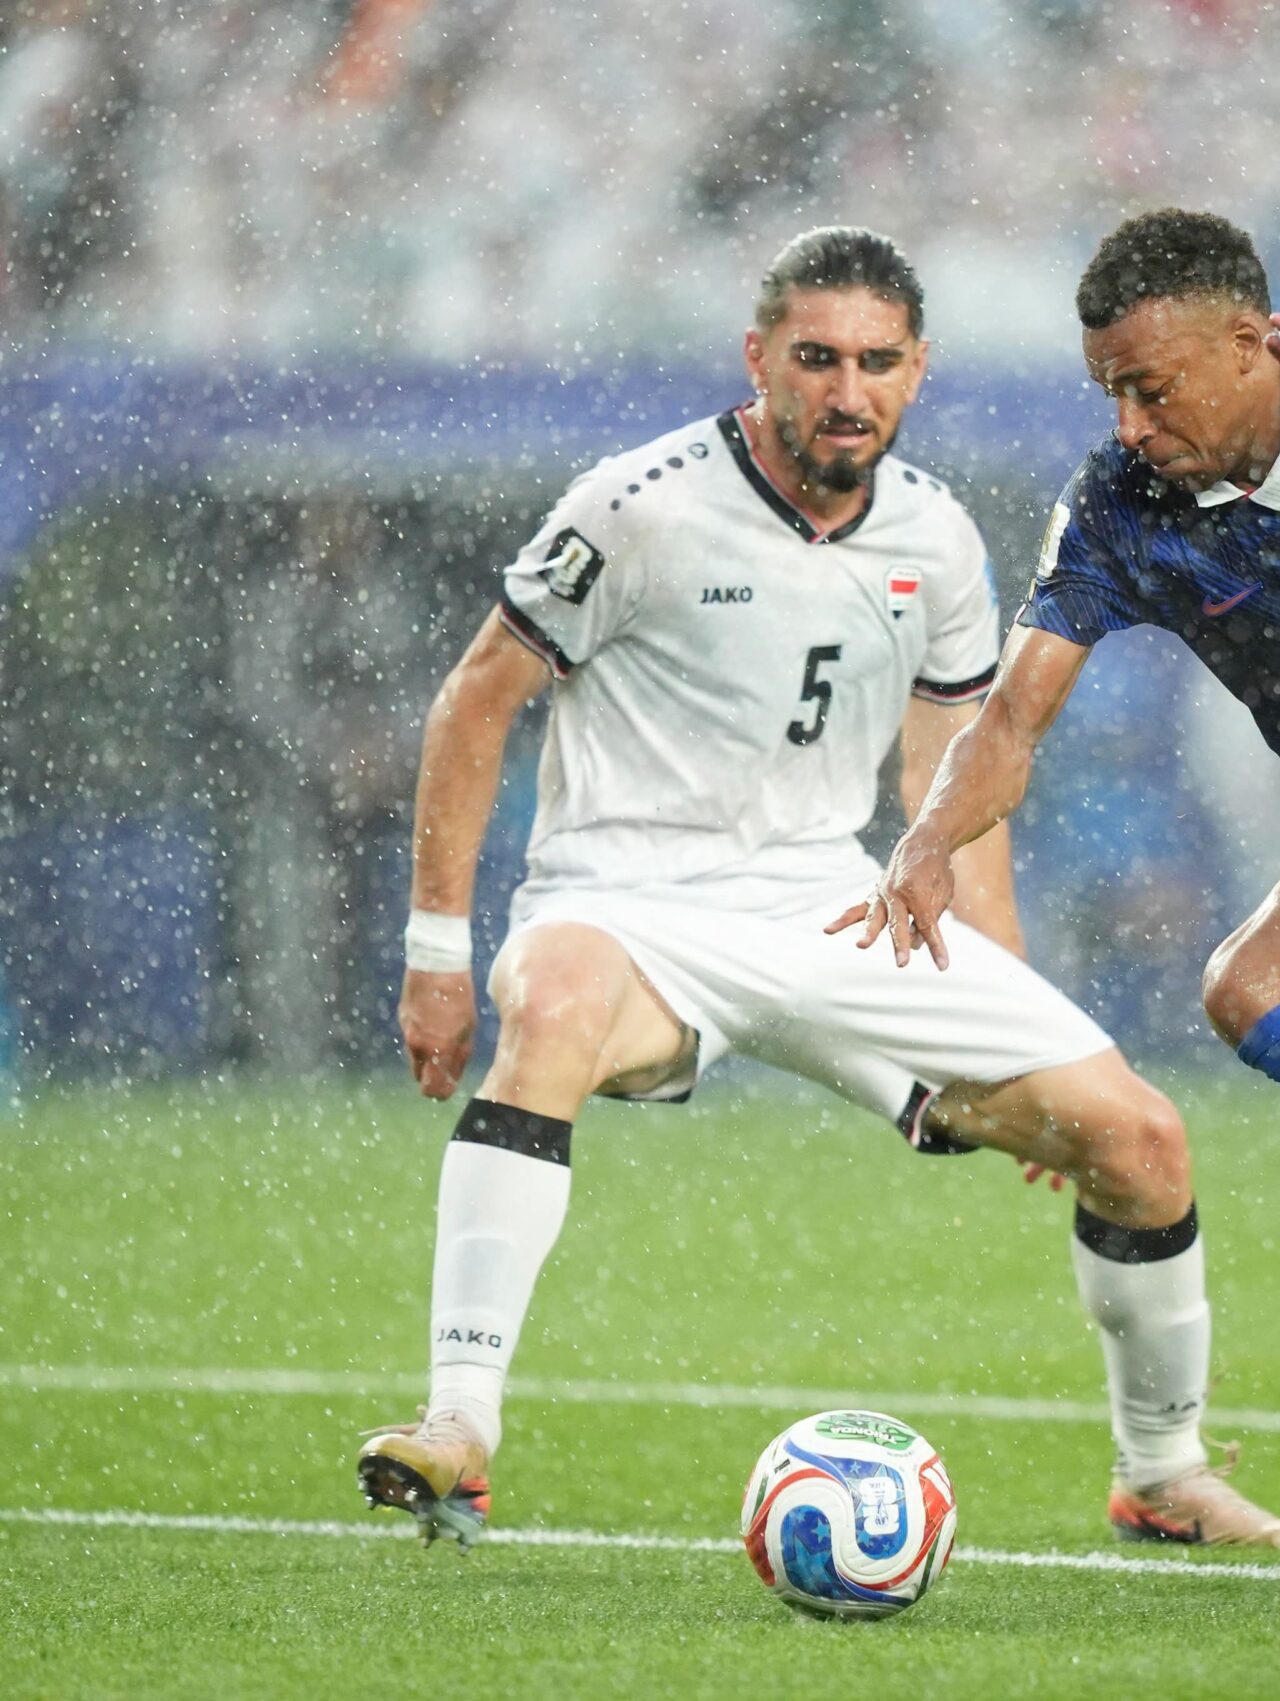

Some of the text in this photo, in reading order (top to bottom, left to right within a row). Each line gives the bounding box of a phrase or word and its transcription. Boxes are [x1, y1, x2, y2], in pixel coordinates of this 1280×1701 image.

[700, 586, 753, 604] JAKO
[786, 644, 842, 746] 5
[437, 1328, 502, 1348] JAKO
[829, 1426, 897, 1445] TRIONDA
